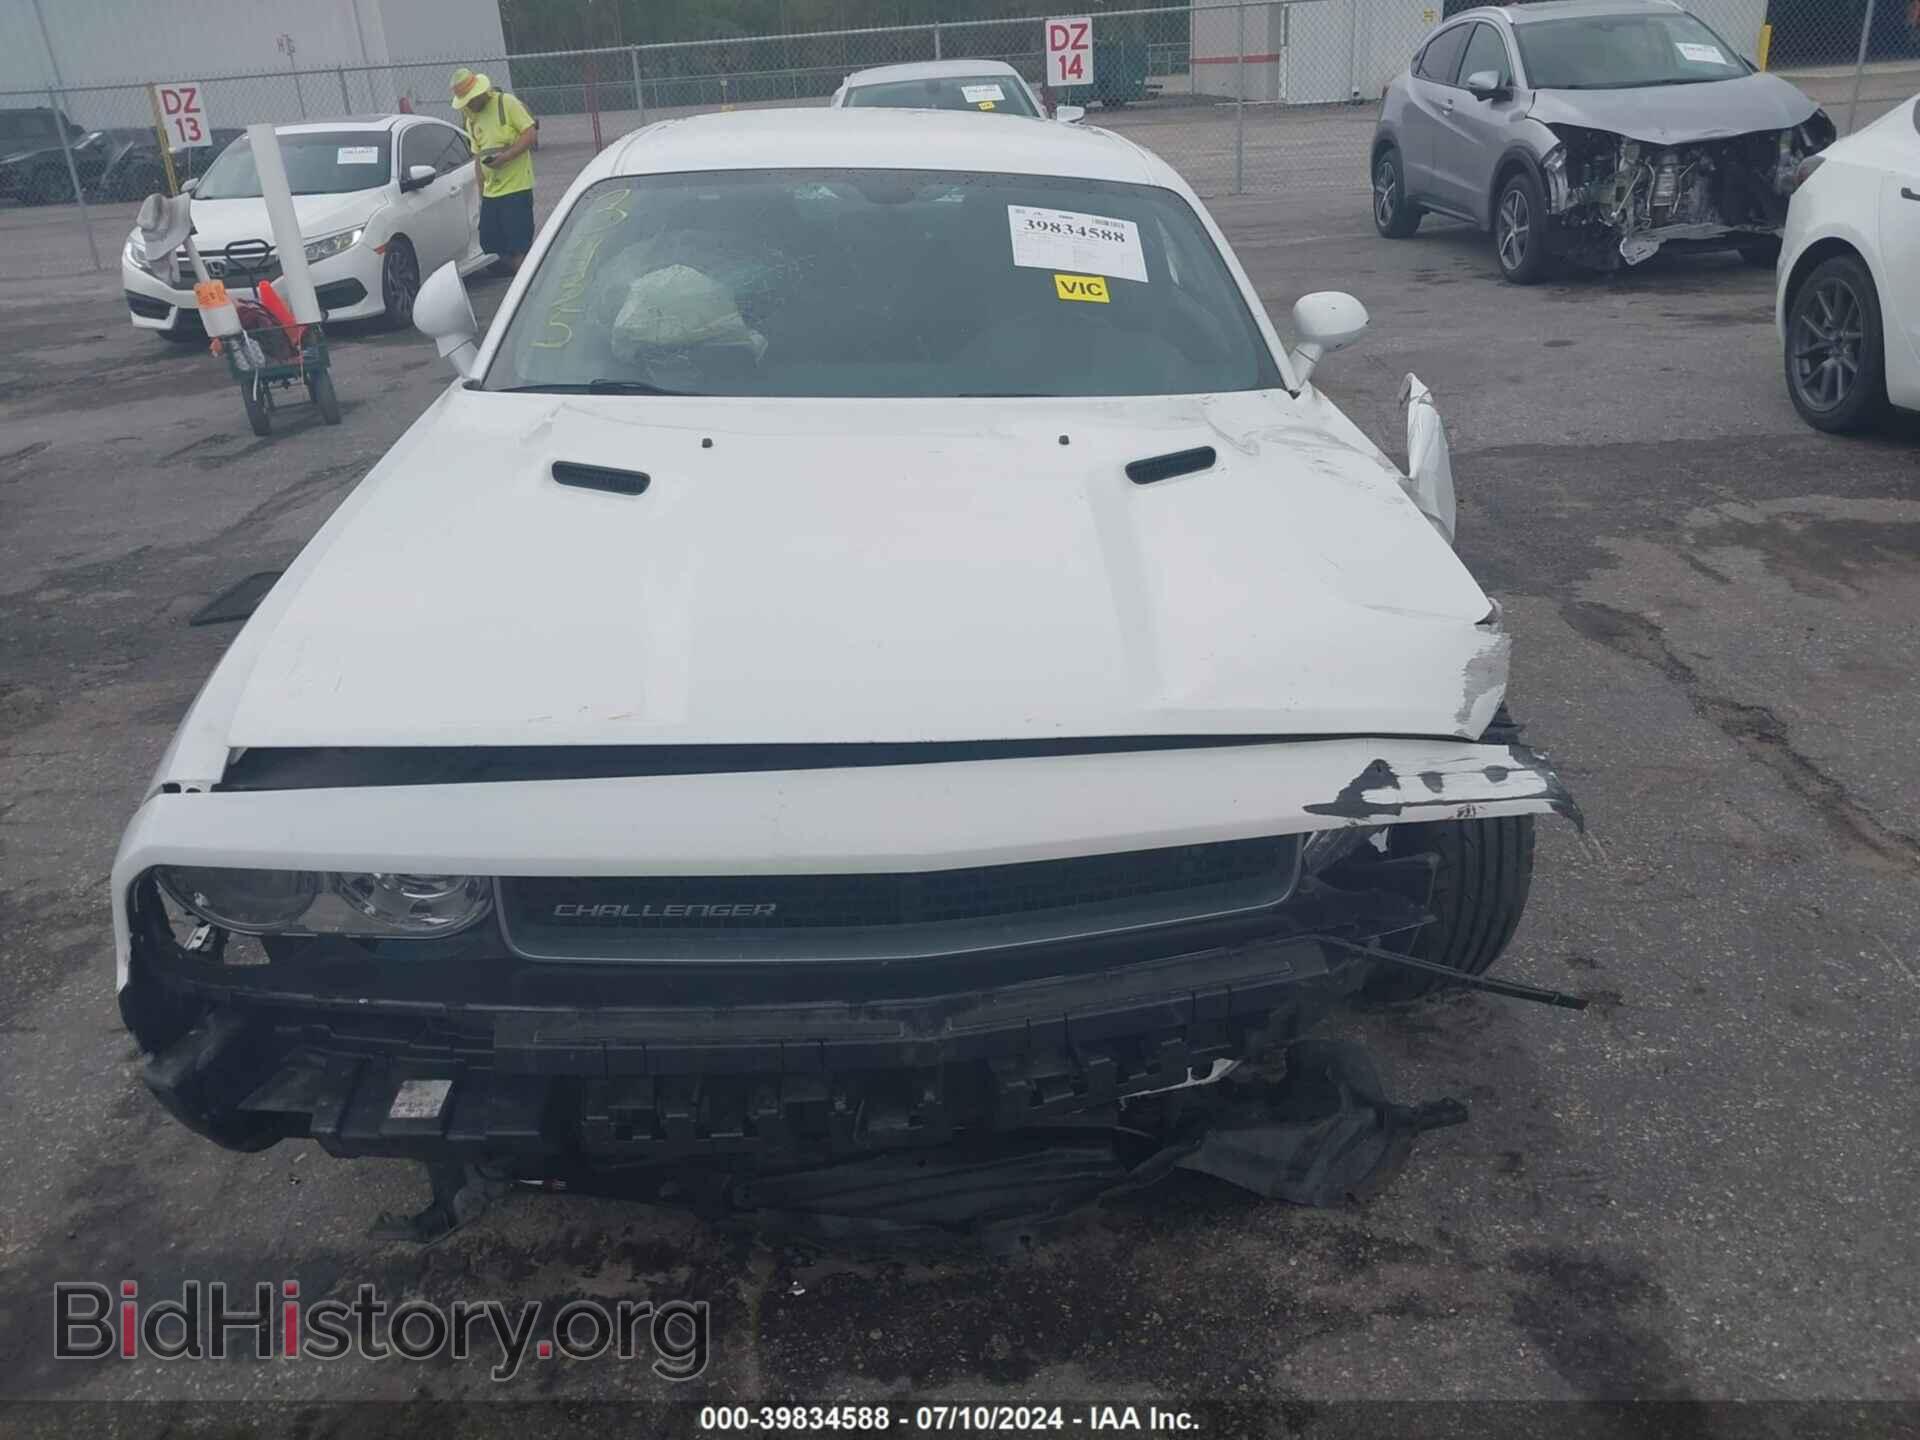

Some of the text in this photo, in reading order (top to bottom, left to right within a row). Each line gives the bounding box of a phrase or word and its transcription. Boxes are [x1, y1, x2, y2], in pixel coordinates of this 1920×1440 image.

[1050, 24, 1089, 51] DZ
[1058, 53, 1084, 81] 14
[161, 88, 200, 115] DZ
[175, 117, 202, 142] 13
[1023, 218, 1126, 243] 39834588
[1060, 279, 1103, 296] VIC
[553, 903, 777, 917] CHALLENGER
